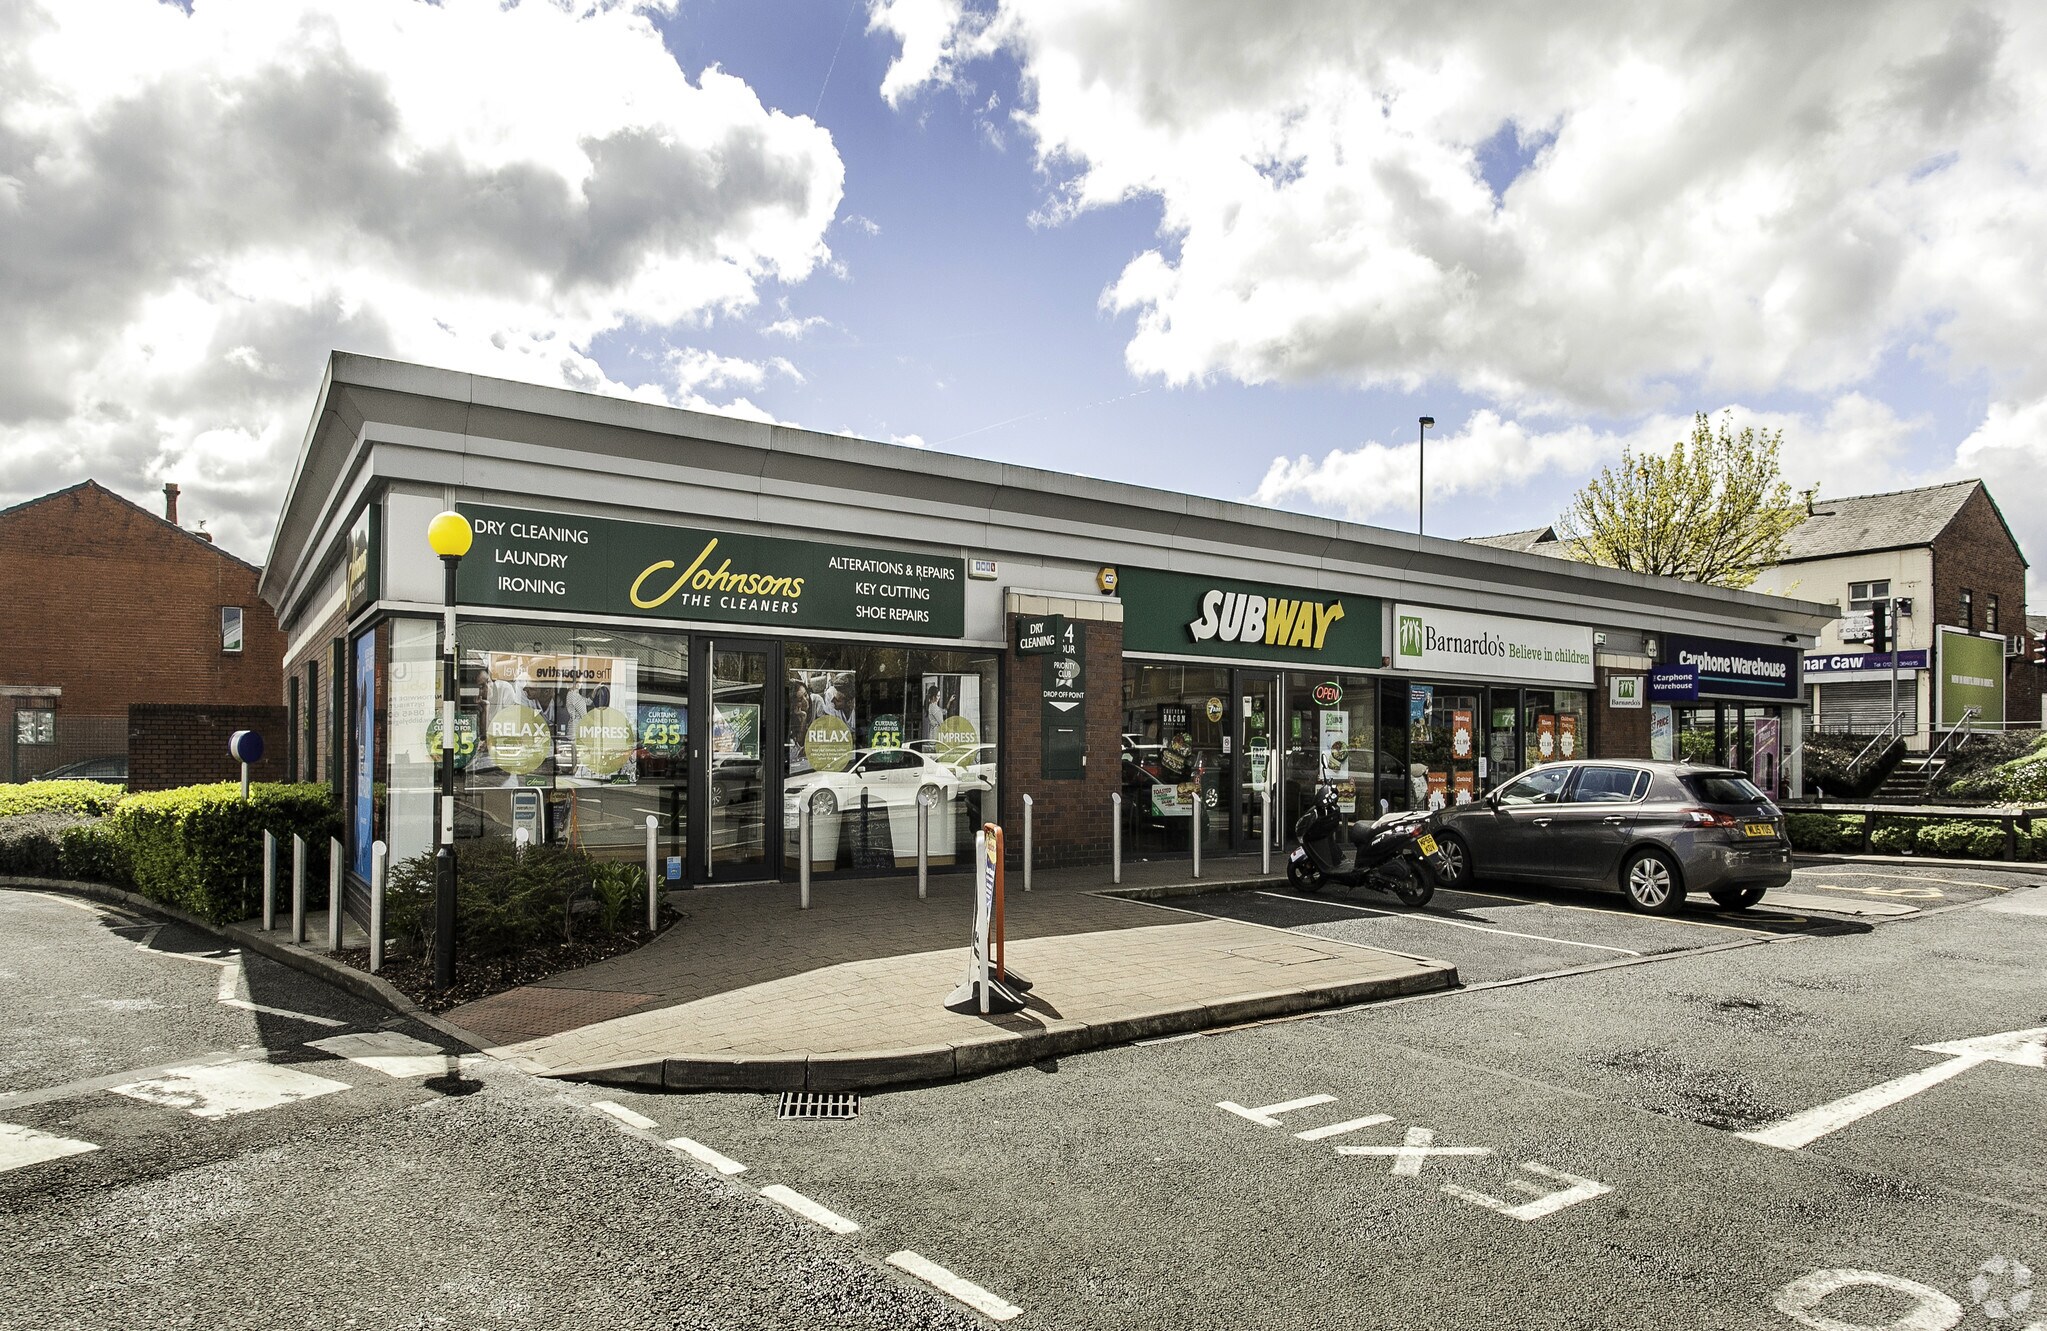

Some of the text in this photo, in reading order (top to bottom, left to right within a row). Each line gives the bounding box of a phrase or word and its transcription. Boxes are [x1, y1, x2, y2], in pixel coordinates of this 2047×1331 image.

[474, 519, 589, 544] DRY CLEANING
[495, 549, 568, 568] LAUNDRY
[629, 537, 805, 609] Johnsons
[828, 556, 955, 581] ALTERATIONS & REPAIRS
[498, 576, 566, 595] IRONING
[855, 582, 930, 600] KEY CUTTING
[681, 593, 798, 614] THE CLEANERS
[856, 605, 929, 623] SHOE REPAIRS
[1190, 589, 1344, 648] SUBWAY
[1030, 622, 1044, 634] DRY
[1020, 635, 1055, 649] CLEANING
[1062, 645, 1076, 654] UR
[1425, 625, 1590, 664] Barnardo's Believe in children
[1053, 662, 1076, 670] PRIORITY
[1679, 650, 1787, 678] Carphone Warehouse
[1830, 656, 1864, 669] Gaw
[1058, 670, 1072, 678] CLUB
[1656, 673, 1693, 682] Carphone
[1316, 686, 1339, 700] OPEN
[1653, 682, 1693, 690] Warehouse
[1043, 690, 1057, 698] DROP
[1068, 691, 1084, 699] POINT
[1163, 714, 1186, 722] BACON
[492, 722, 546, 738] RELAX
[580, 726, 630, 739] IMPRESS
[644, 724, 681, 745] £35
[808, 730, 849, 742] RELAX
[938, 732, 975, 743] IMPRESS
[871, 732, 901, 750] £35
[1214, 1093, 1613, 1222] EXIT
